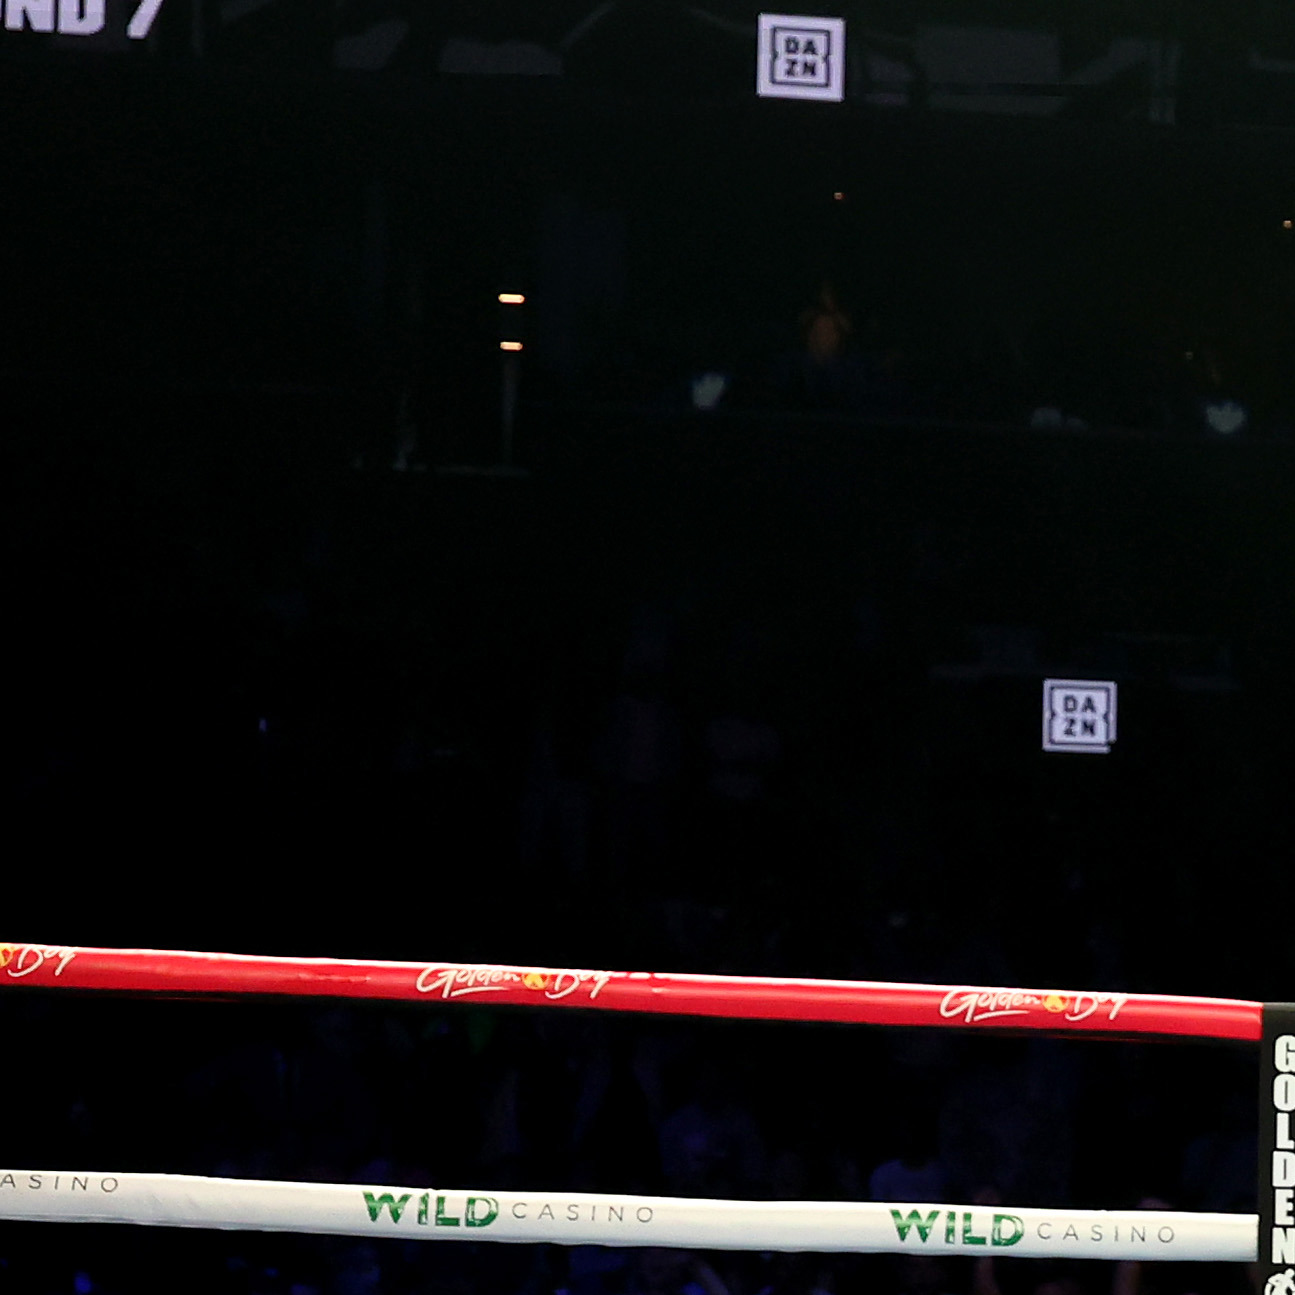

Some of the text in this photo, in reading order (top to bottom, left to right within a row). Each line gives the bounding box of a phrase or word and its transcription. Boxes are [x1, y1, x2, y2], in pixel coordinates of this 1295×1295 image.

[1064, 694, 1097, 713] DA
[0, 1173, 119, 1193] ASINO
[362, 1191, 654, 1227] WILD CASINO
[889, 1209, 1176, 1246] WILD CASINO
